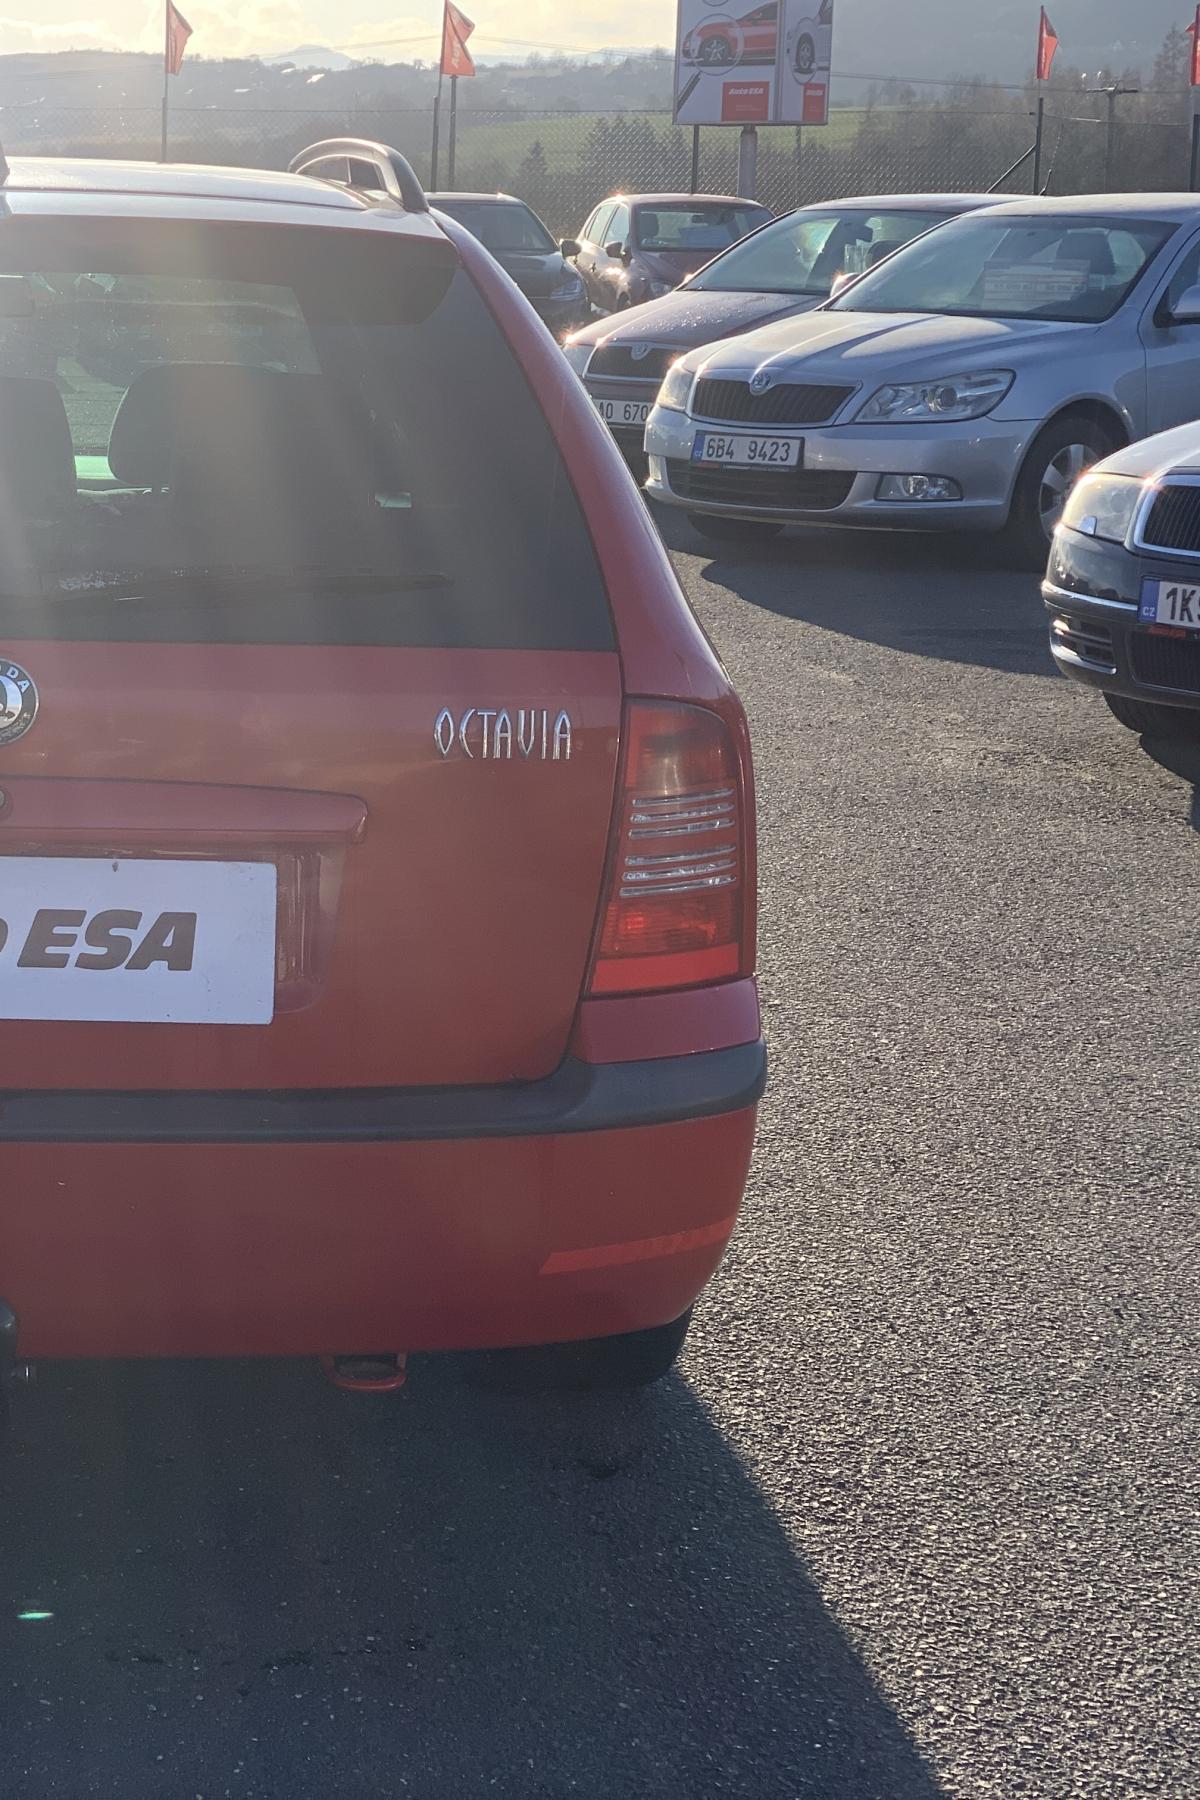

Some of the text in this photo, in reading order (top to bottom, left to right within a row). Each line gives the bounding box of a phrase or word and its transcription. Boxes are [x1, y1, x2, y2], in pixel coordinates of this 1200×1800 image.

[623, 403, 651, 422] 670
[706, 438, 791, 462] 6B4 9423
[1143, 606, 1155, 617] CZ
[1166, 587, 1200, 623] 1K
[433, 707, 572, 760] OCTAVIA
[16, 908, 198, 972] ESA
